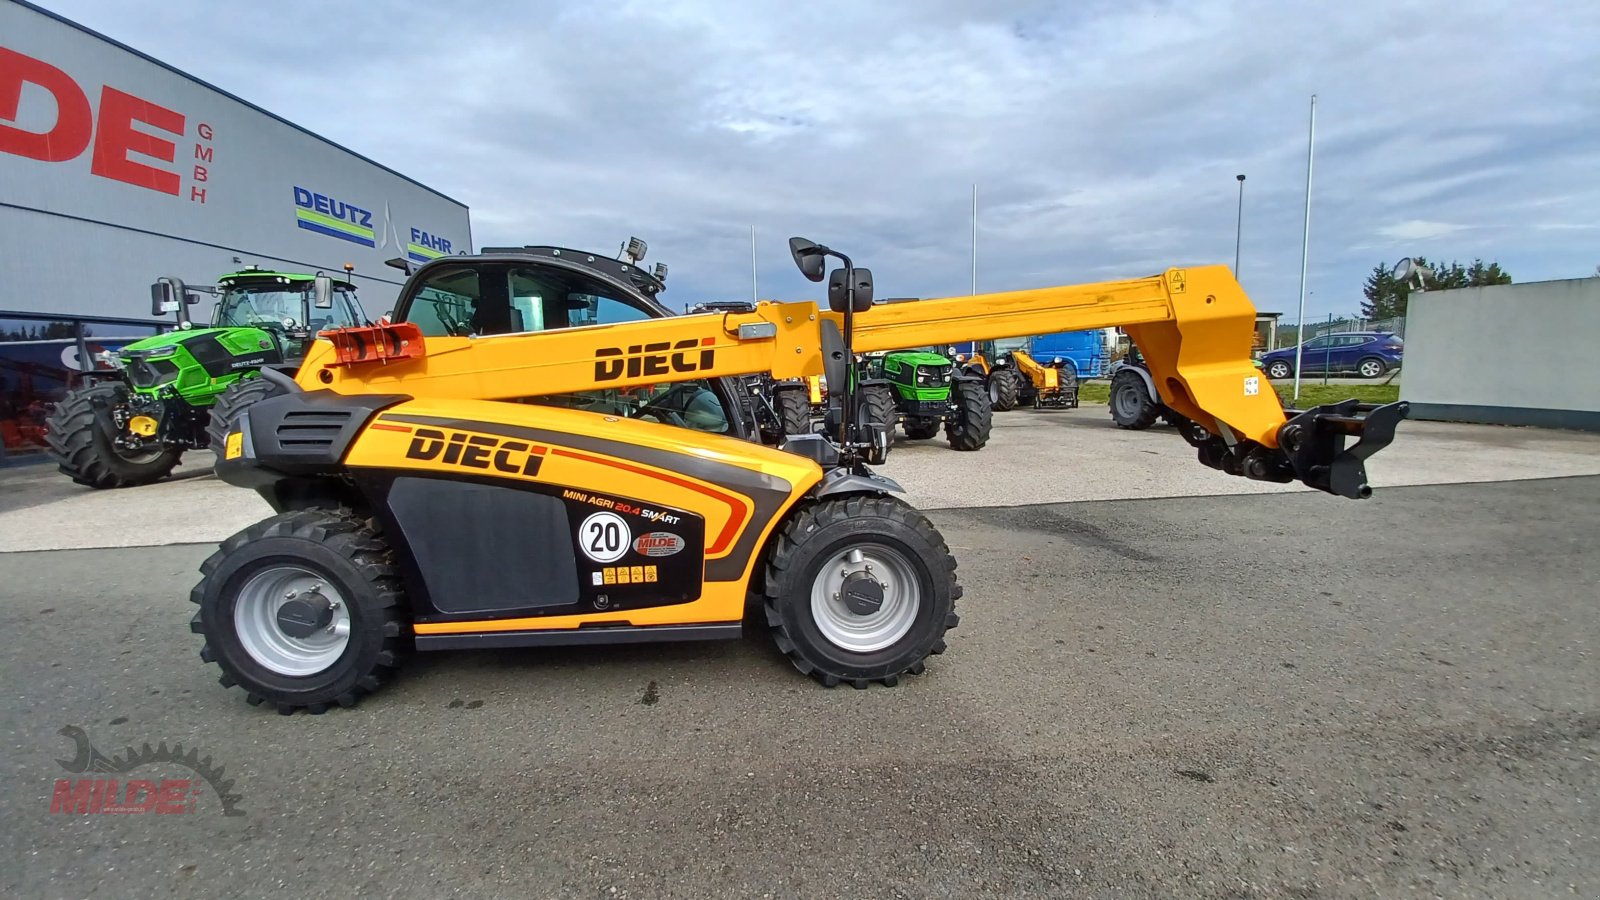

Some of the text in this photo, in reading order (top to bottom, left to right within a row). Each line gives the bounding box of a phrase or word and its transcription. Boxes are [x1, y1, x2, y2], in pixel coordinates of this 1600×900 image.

[191, 123, 213, 204] GMBH
[293, 186, 452, 255] DEUTZ FAHR
[231, 358, 265, 368] DEUTZ-FAHR
[563, 490, 680, 525] MINI AGRI 20.4 SMART
[590, 522, 620, 552] 20
[637, 537, 676, 548] MILDE
